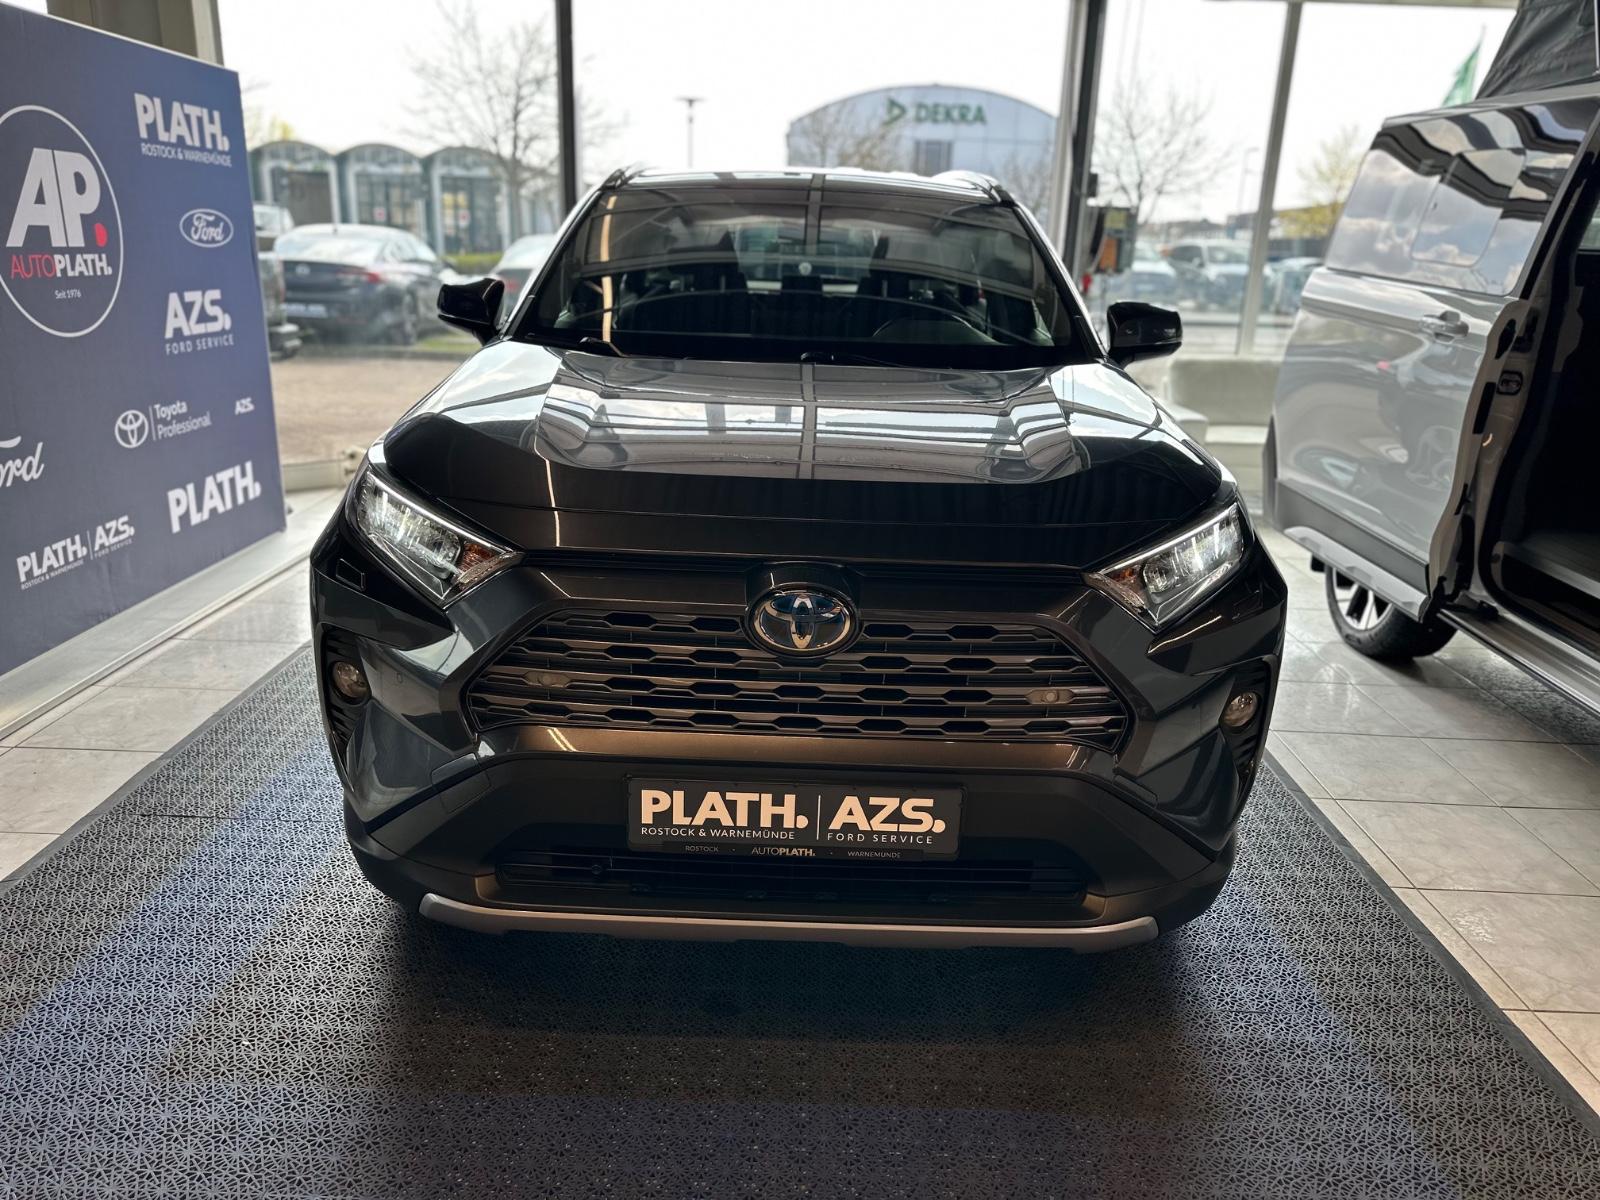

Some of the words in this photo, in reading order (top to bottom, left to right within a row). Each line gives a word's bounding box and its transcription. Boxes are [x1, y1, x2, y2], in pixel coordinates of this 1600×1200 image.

[134, 92, 230, 152] PLATH.
[914, 102, 988, 126] DEKRA
[141, 142, 177, 159] ROSTOCK
[191, 213, 224, 241] Ford
[10, 253, 113, 280] AUTOPLATH.
[54, 290, 67, 299] Seit
[67, 288, 82, 299] 1976
[164, 289, 232, 339] AZS.
[165, 340, 193, 355] FORD
[196, 333, 234, 351] SERVICE
[154, 400, 188, 421] Toyota
[157, 411, 212, 440] Professional
[167, 460, 262, 534] PLATH.
[94, 515, 135, 552] AZS.
[16, 534, 88, 583] PLATH.
[641, 789, 809, 829] PLATH.
[828, 795, 946, 833] AZS.
[641, 827, 695, 837] ROSTOCK
[698, 828, 706, 837] &
[710, 829, 795, 840] WARNEMÜNDE
[827, 832, 865, 842] FORD
[873, 834, 933, 845] SERVICE
[685, 845, 719, 853] ROSTOCK
[751, 847, 816, 857] AUTOPLATH.
